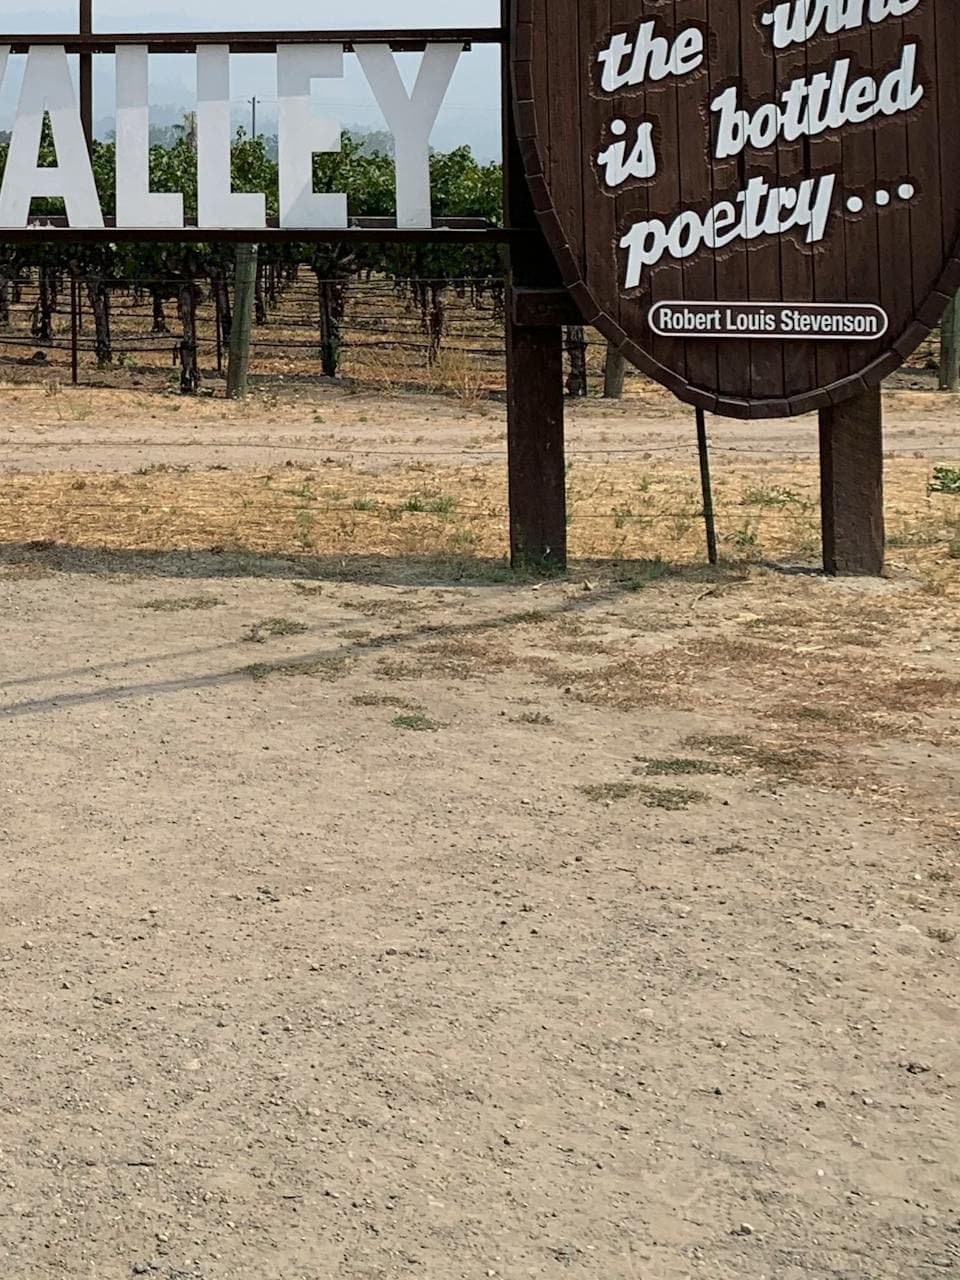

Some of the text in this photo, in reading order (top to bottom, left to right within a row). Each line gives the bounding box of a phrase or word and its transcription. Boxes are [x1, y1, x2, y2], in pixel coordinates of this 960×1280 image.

[597, 20, 704, 92] the
[596, 43, 924, 187] is bottled
[659, 308, 877, 333] Robert Louis Stevenson
